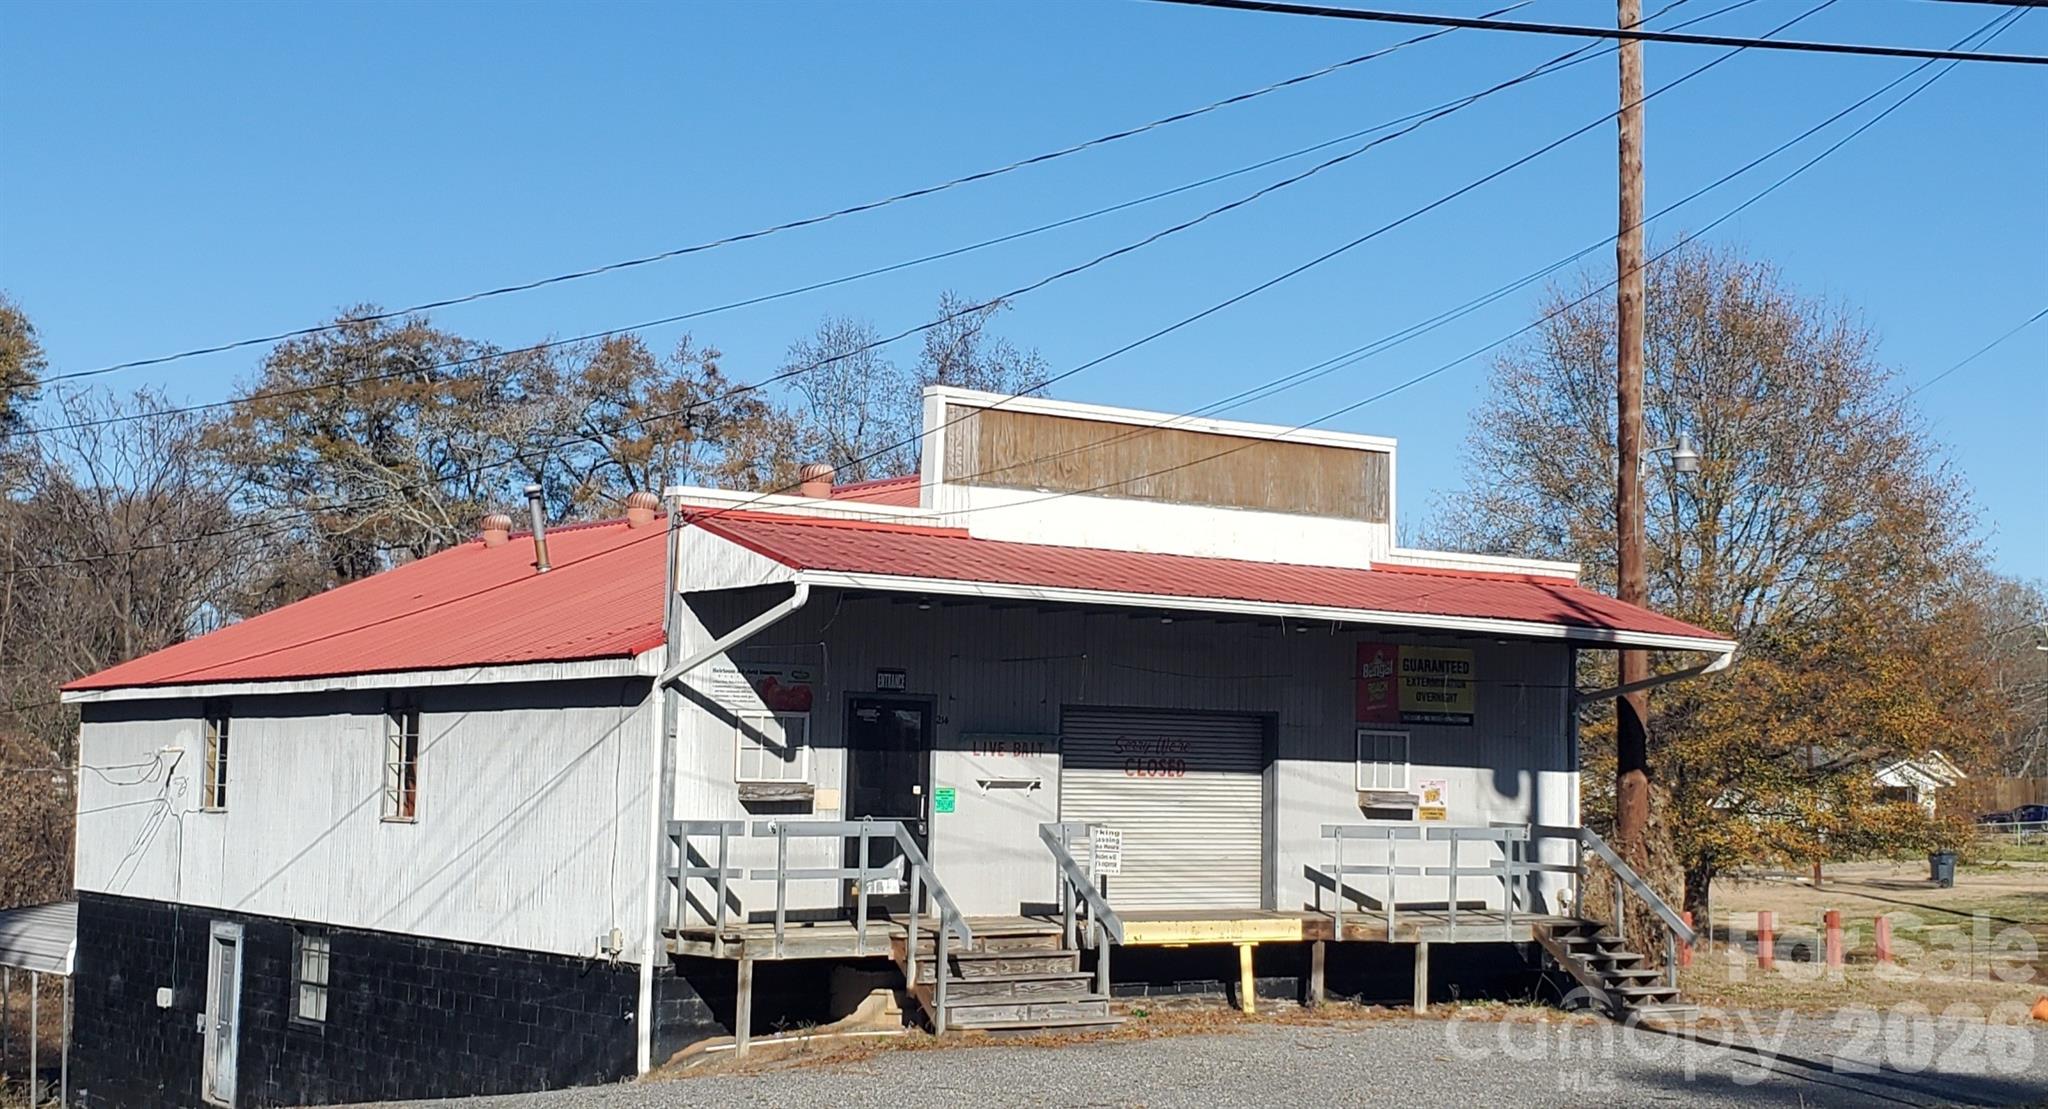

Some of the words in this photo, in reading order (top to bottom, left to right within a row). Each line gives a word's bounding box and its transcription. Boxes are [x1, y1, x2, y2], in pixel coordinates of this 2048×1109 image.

[1362, 659, 1393, 678] Bengal
[1402, 657, 1470, 675] GUARANTEED
[877, 673, 906, 690] ENTRANCE
[1415, 691, 1458, 704] OVERNIGHT
[972, 741, 1005, 757] LIVE
[1013, 741, 1044, 758] BAIT
[1124, 757, 1186, 777] CLOSED
